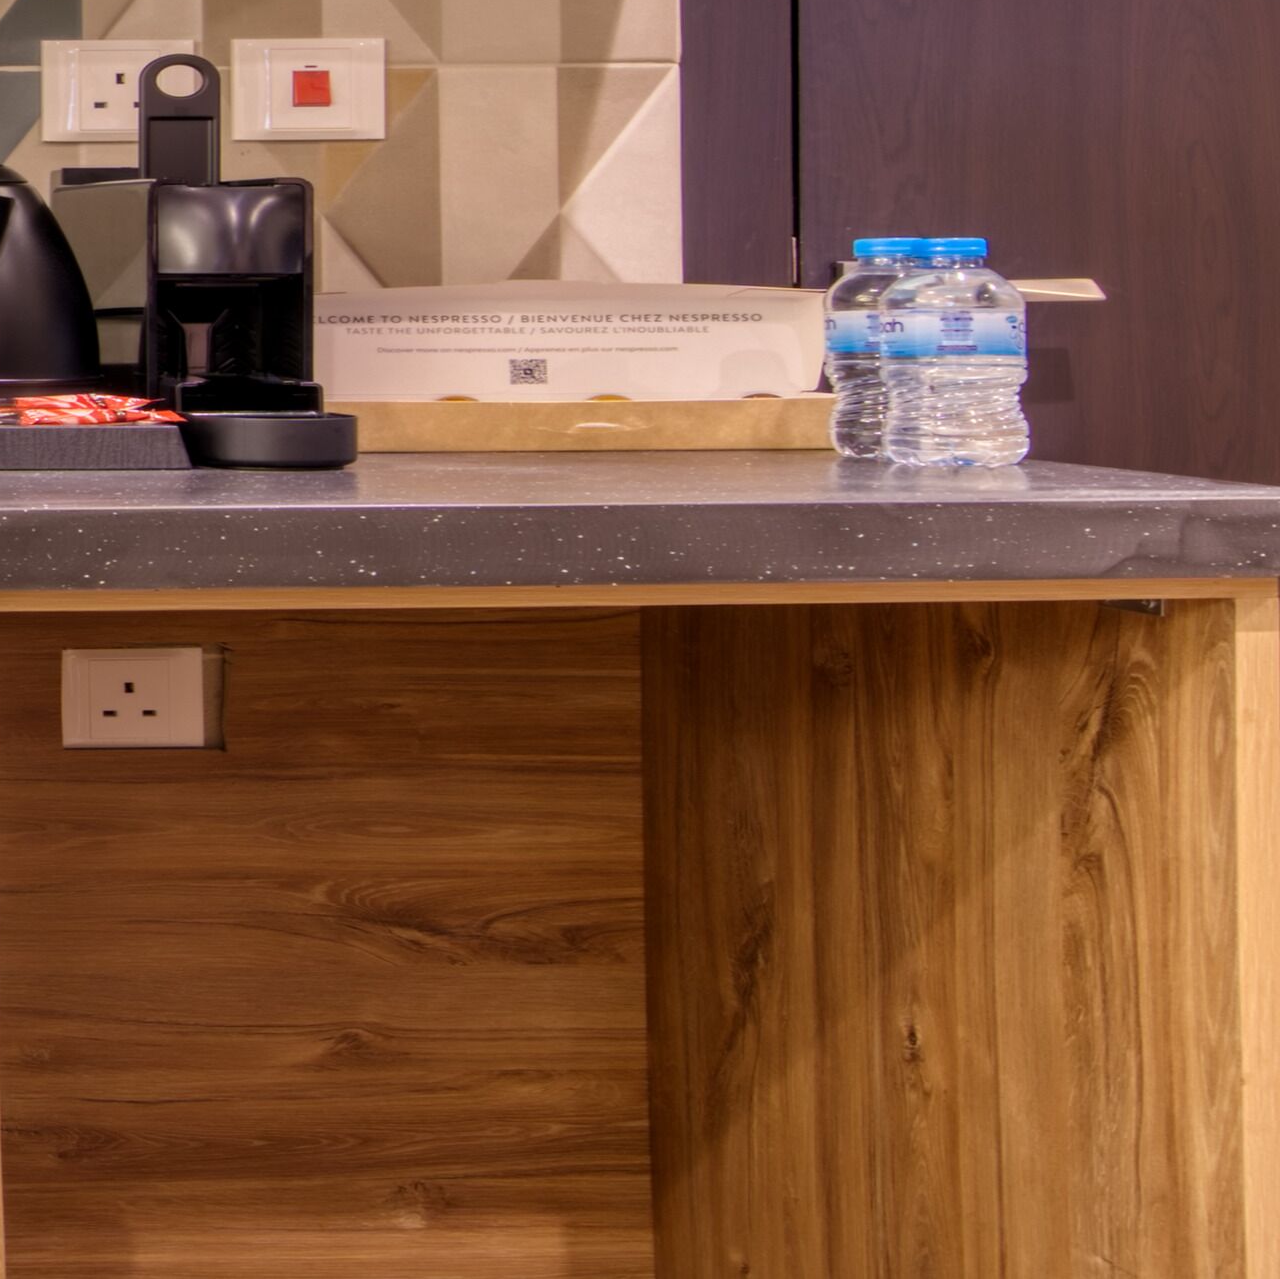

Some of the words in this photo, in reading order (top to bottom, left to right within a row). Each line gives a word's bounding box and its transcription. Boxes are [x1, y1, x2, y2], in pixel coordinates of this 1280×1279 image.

[380, 315, 402, 324] TO
[408, 314, 502, 324] NESPRESSO
[520, 314, 613, 323] BIENVENUE
[619, 313, 662, 323] CHEZ
[669, 313, 763, 323] NESPRESSO
[346, 327, 383, 335] TASTE
[388, 327, 413, 335] THE
[416, 327, 526, 335] UNFORGETTABLE
[540, 326, 609, 334] SAVOUREZ
[612, 326, 709, 334] L'INOUBLIABLE
